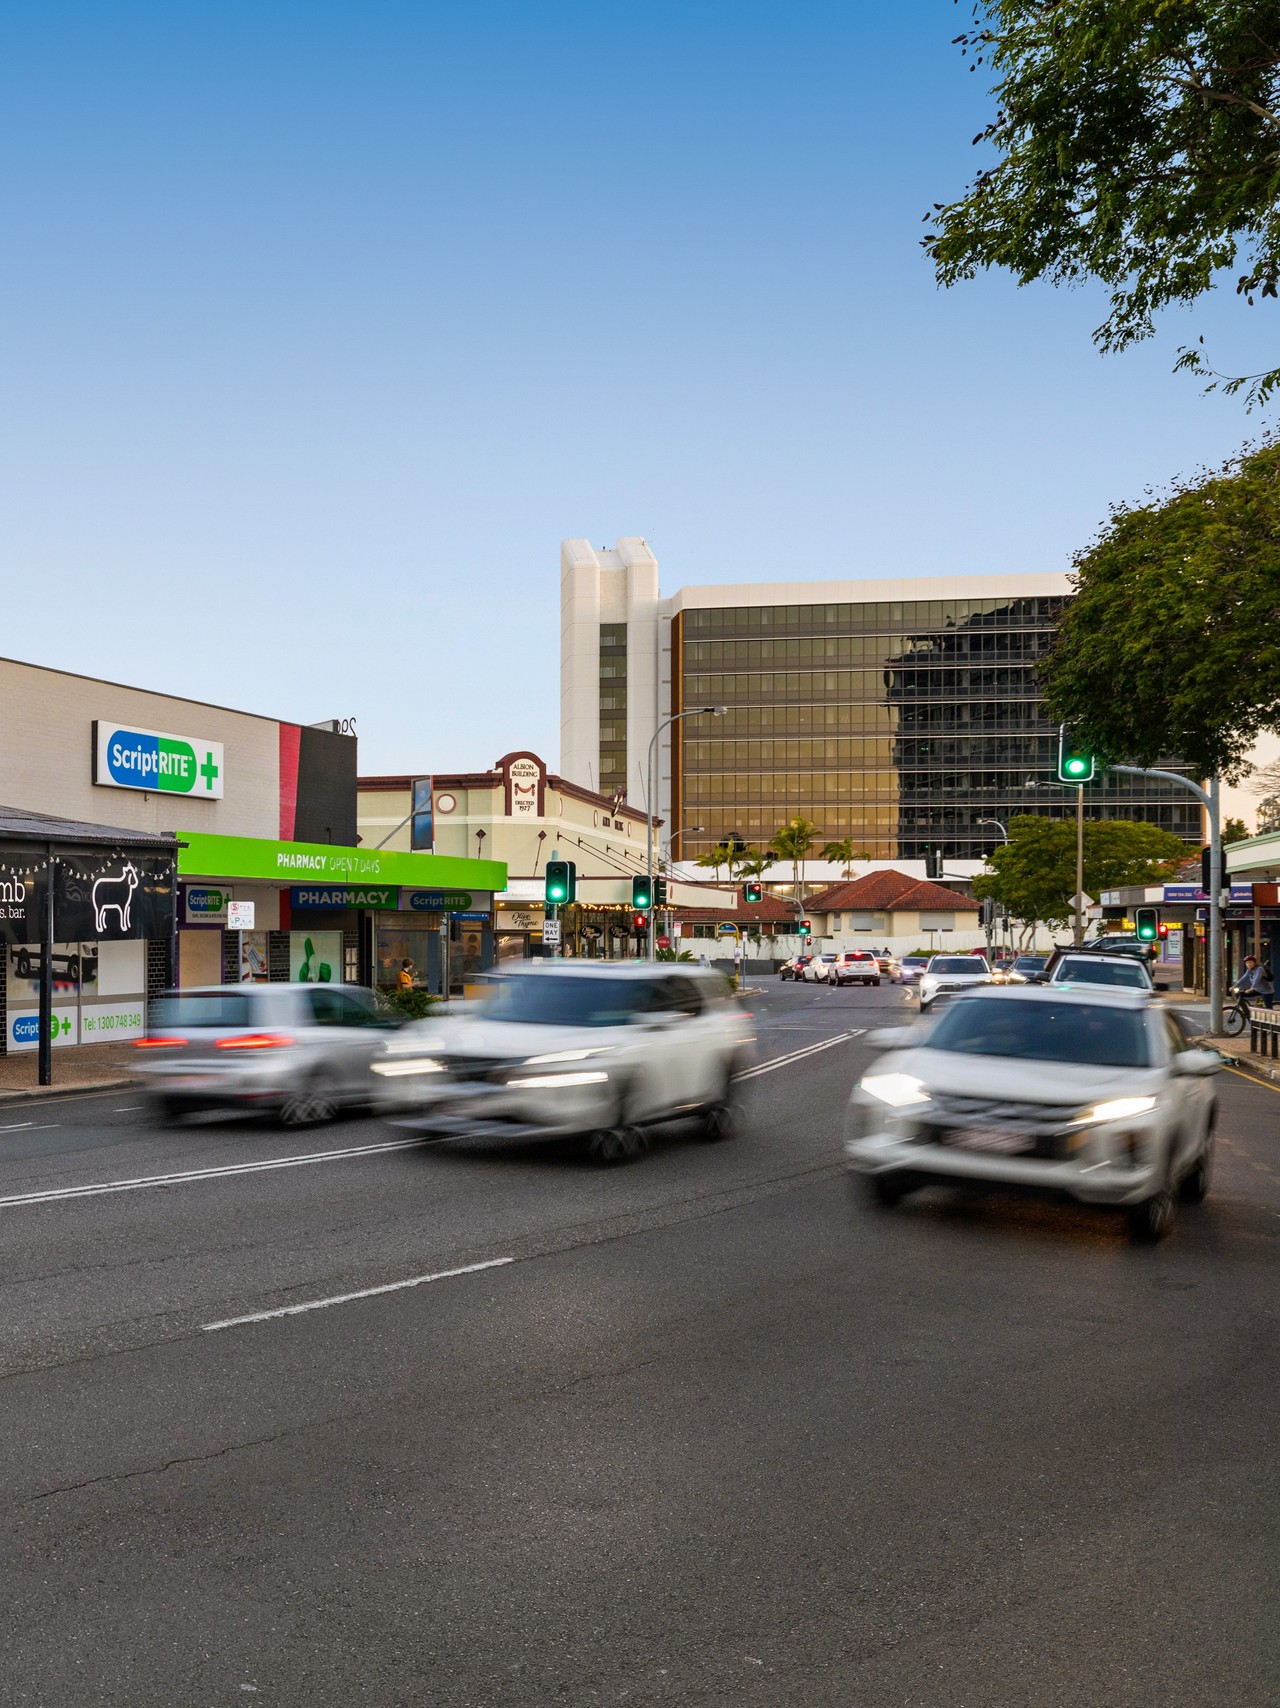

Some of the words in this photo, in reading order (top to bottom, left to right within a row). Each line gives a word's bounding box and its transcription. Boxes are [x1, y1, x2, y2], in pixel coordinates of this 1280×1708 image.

[511, 770, 538, 778] BUILDING
[277, 852, 327, 870] PHARMACY
[329, 857, 353, 872] OPEN
[354, 857, 359, 872] 7
[360, 859, 380, 874] DAYS
[189, 894, 220, 908] ScriptRITE
[298, 891, 390, 905] PHARMACY
[413, 896, 466, 907] ScriptRITE
[8, 904, 26, 919] bar.
[511, 912, 531, 921] Olive
[514, 919, 539, 929] Thyme
[83, 1017, 97, 1031] Tel:
[98, 1015, 115, 1030] 1300
[115, 1014, 128, 1028] 748
[129, 1013, 141, 1027] 349
